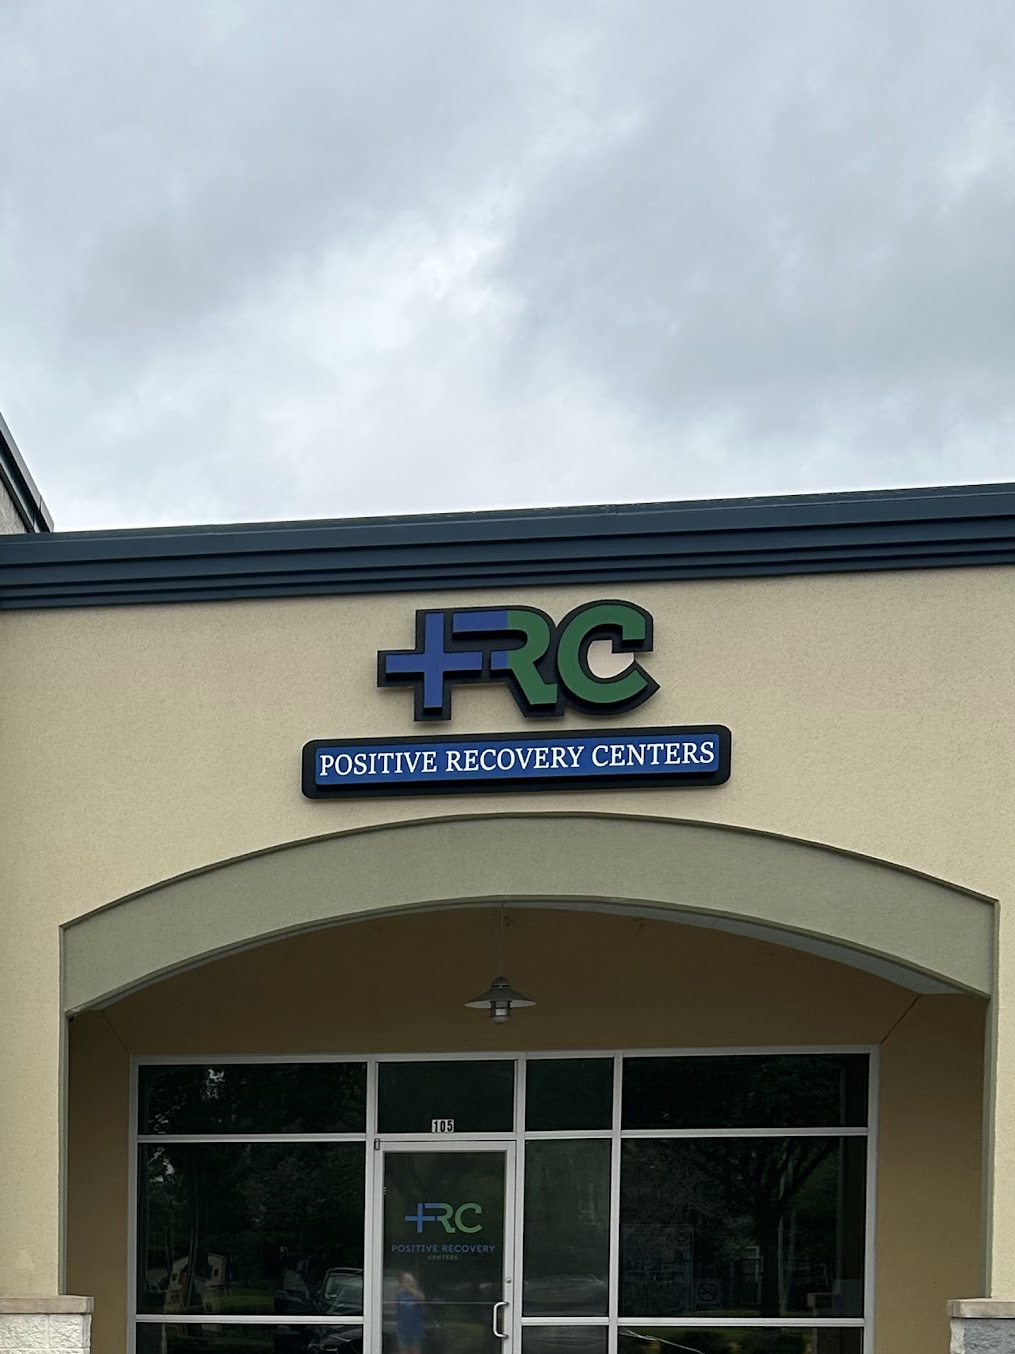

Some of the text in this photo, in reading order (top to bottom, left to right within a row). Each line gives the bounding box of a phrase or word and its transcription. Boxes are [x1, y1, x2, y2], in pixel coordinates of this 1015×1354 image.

[319, 740, 715, 777] POSITIVE RECOVERY CENTERS
[433, 1120, 453, 1132] 105
[391, 1244, 496, 1253] POSITIVE RECOVERY
